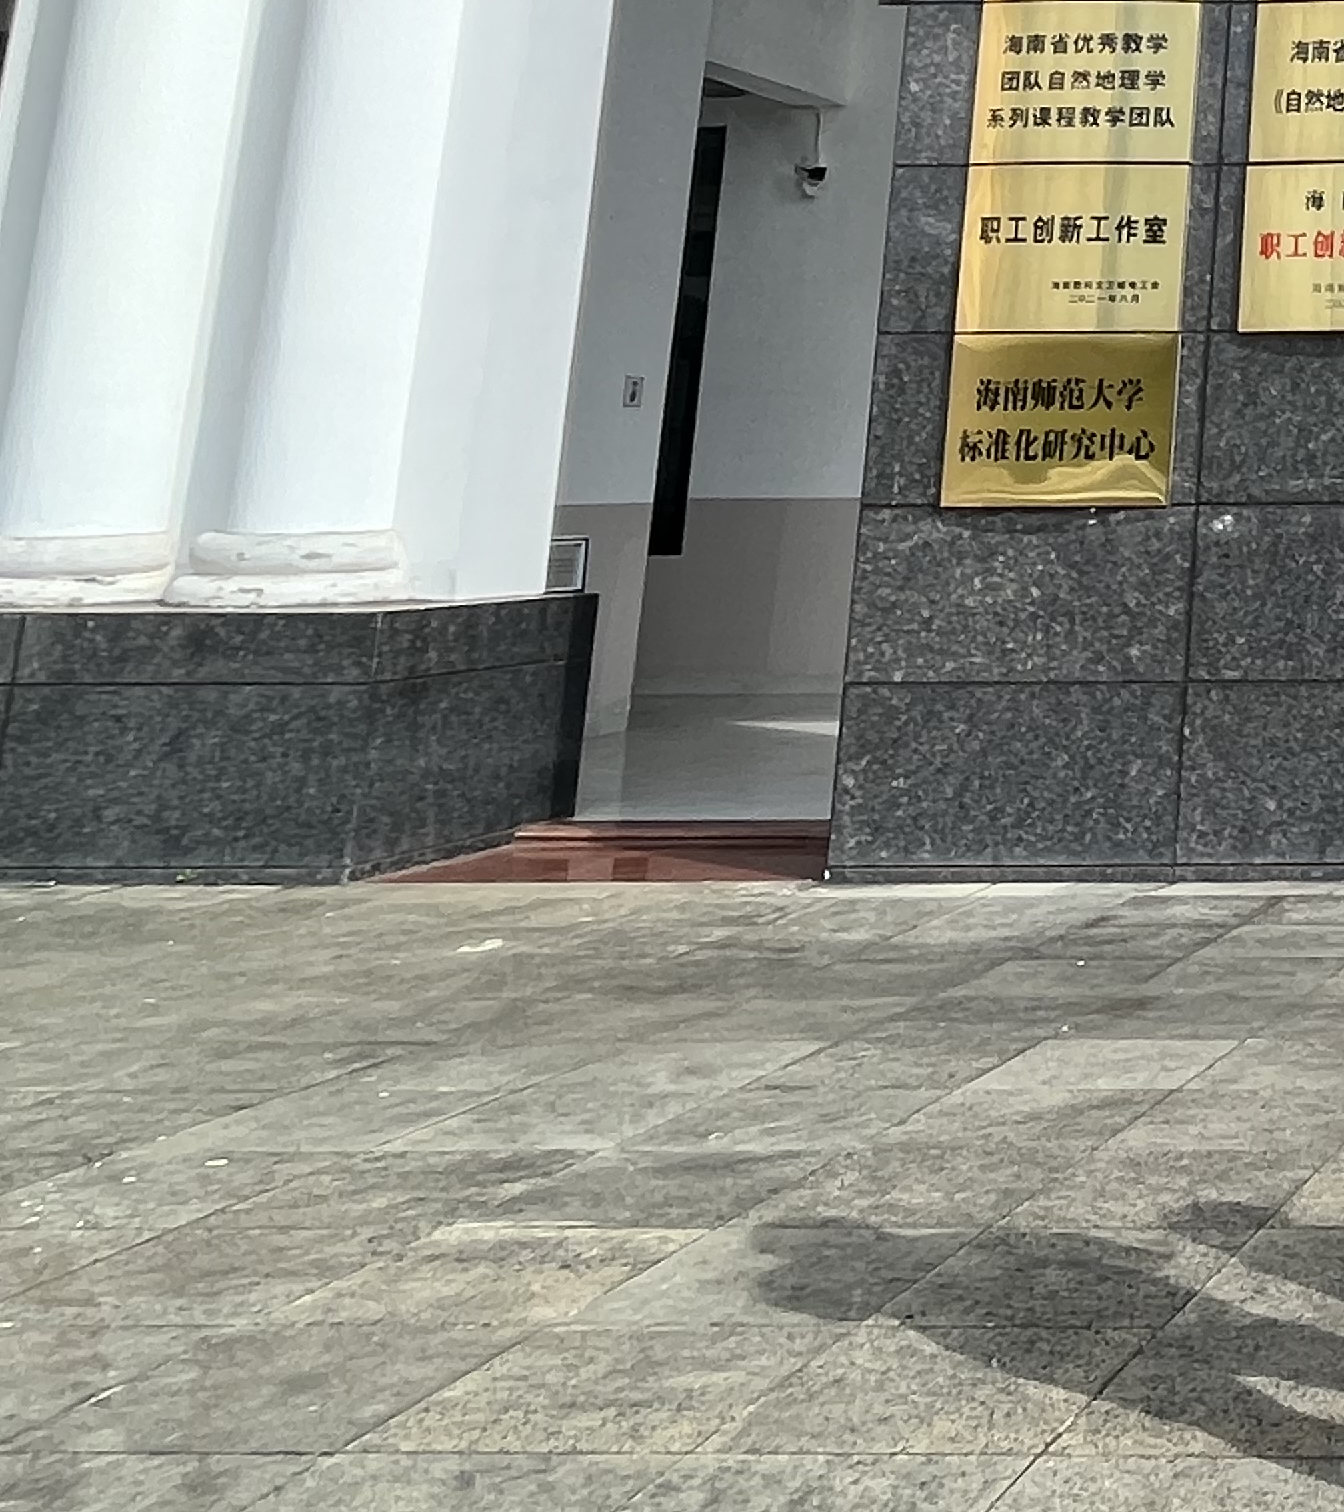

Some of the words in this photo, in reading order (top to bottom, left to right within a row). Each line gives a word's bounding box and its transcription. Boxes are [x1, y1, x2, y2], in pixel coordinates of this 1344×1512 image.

[1003, 32, 1169, 56] 海南省优秀教学
[1000, 69, 1166, 92] 团队自然地理学
[987, 106, 1175, 129] 系列课程教学团队
[979, 214, 1168, 245] 职工创新工作室
[976, 376, 1145, 412] 海南师范大学
[958, 426, 1156, 463] 标准化研究中心
